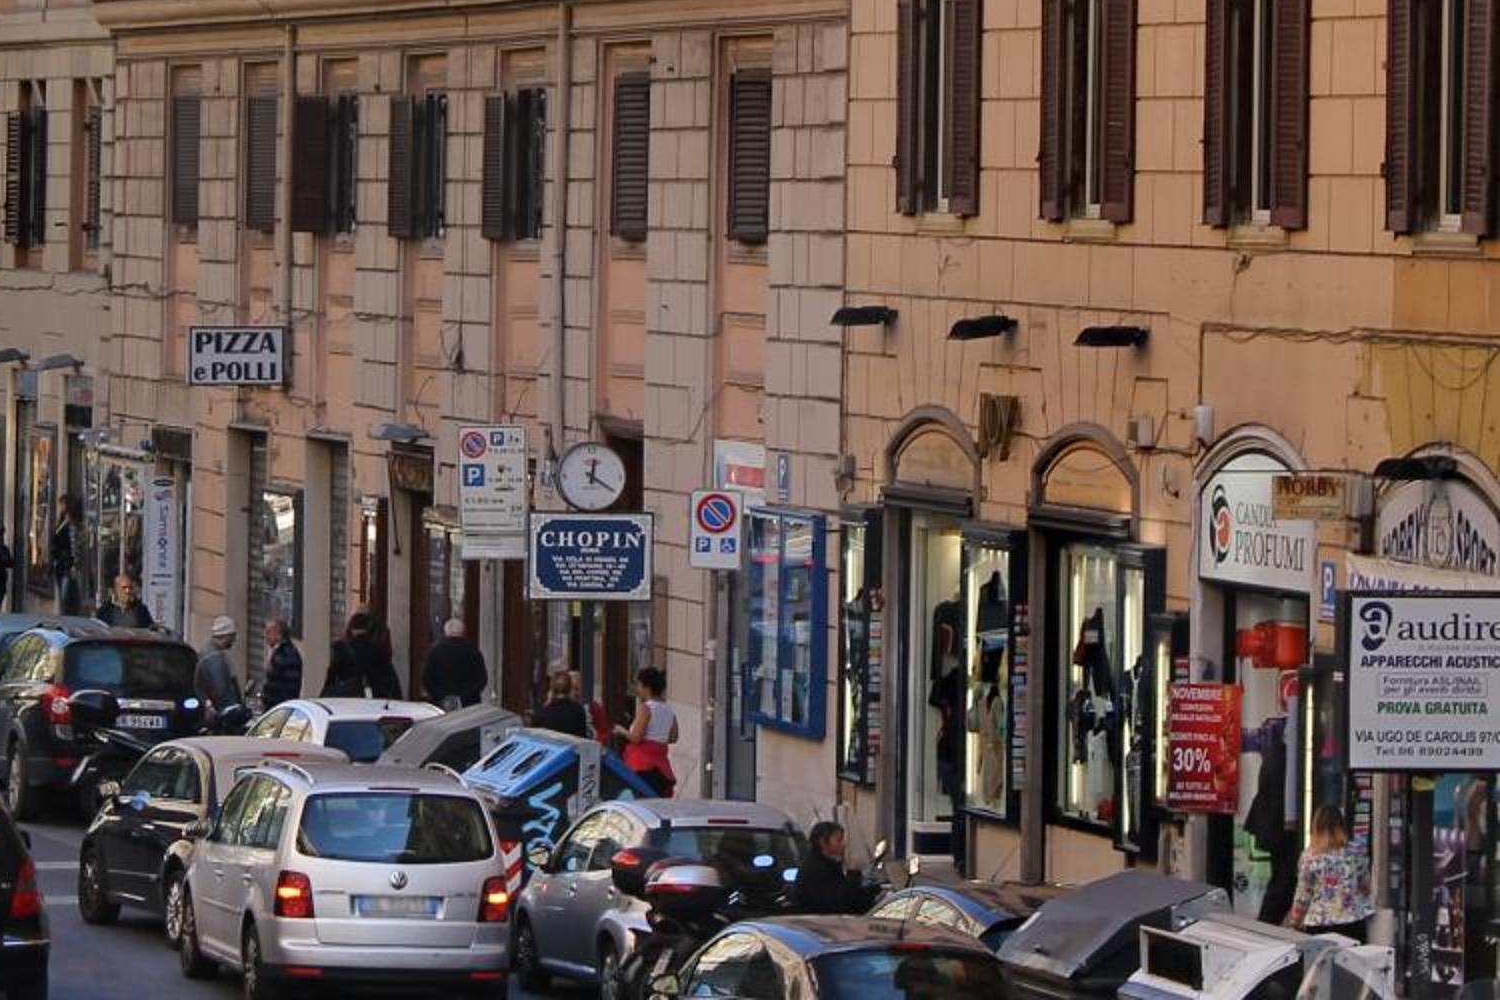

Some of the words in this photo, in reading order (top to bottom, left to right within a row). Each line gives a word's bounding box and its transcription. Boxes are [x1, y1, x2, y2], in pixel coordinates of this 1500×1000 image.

[195, 332, 276, 354] PIZZA
[194, 366, 206, 381] e
[211, 362, 276, 381] POLLI
[540, 531, 641, 548] CHOPIN
[1455, 509, 1496, 576] SPORT
[1234, 530, 1305, 572] PROFUMI
[1361, 655, 1443, 668] APPARECCHI
[1378, 701, 1421, 715] PROVA
[1425, 701, 1488, 715] GRATUITA
[1355, 730, 1374, 743] VIA
[1377, 730, 1402, 743] UGO
[1406, 730, 1423, 743] DE
[1425, 731, 1476, 743] CAROLIS
[1173, 747, 1211, 774] 30%
